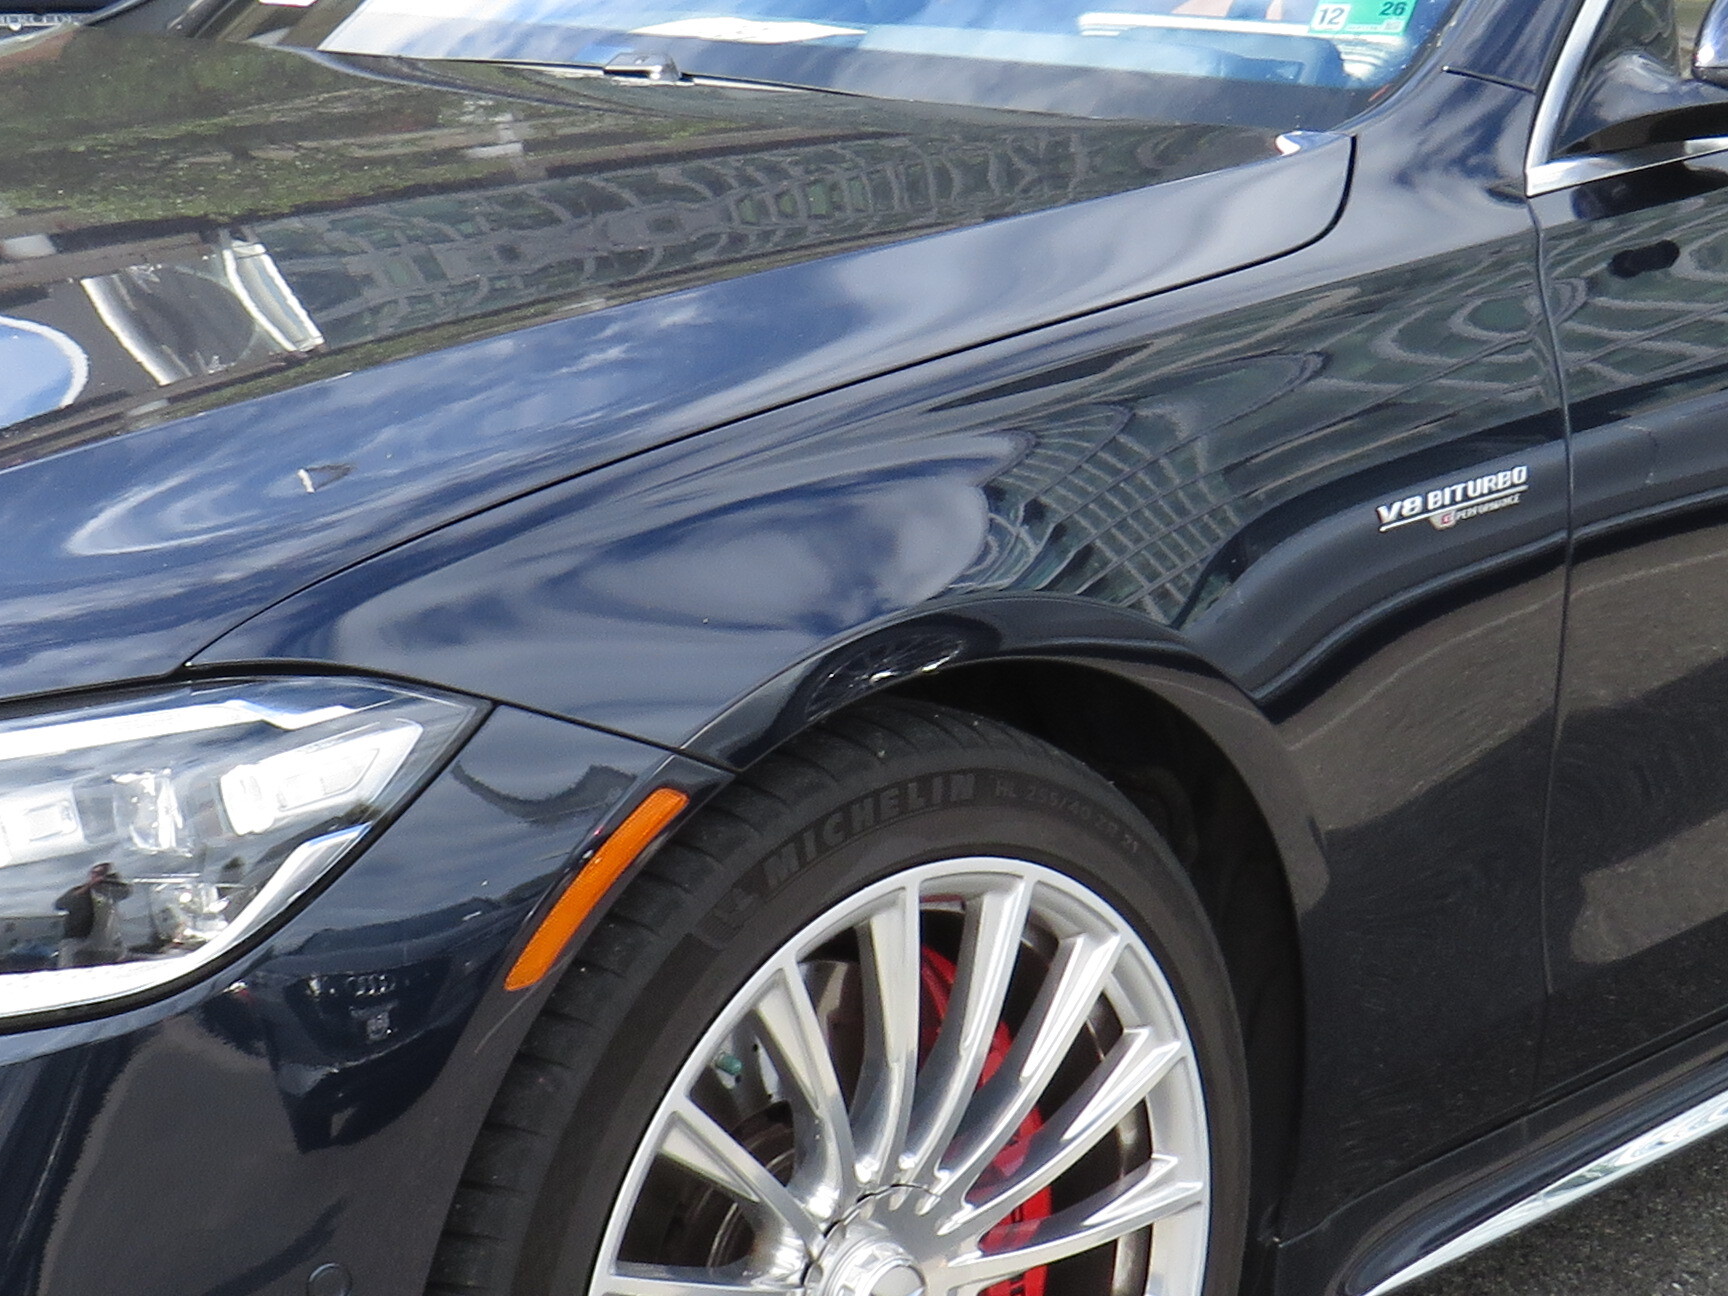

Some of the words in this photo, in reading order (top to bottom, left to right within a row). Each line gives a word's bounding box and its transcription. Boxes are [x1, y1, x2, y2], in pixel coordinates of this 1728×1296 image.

[1318, 7, 1345, 26] 12
[1377, 495, 1423, 524] V8
[1427, 465, 1529, 510] BITURBO
[762, 772, 976, 888] MICHELIN
